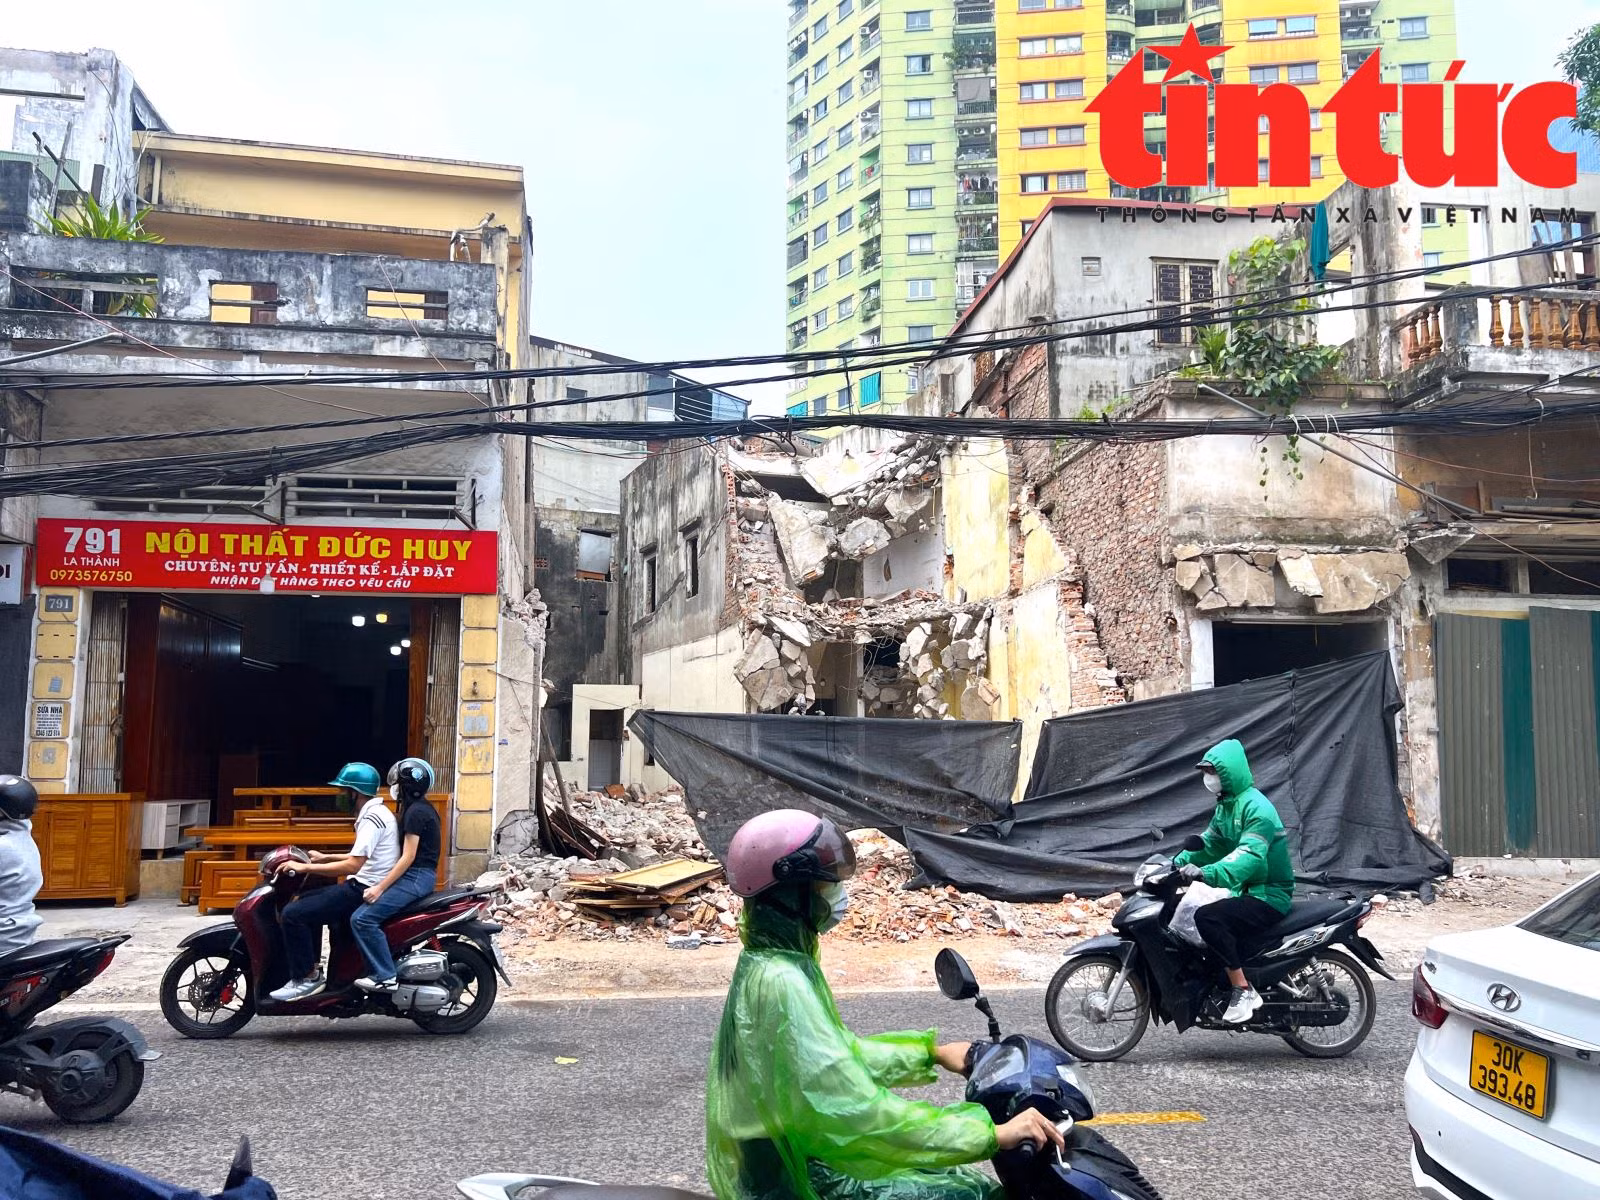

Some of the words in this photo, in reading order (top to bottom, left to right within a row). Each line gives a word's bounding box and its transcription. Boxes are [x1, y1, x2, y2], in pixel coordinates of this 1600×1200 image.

[64, 527, 121, 554] 791
[145, 528, 209, 558] NỘI
[220, 528, 308, 556] THẤT
[318, 532, 391, 559] ĐỨC
[403, 538, 472, 560] HUY
[64, 557, 78, 567] LA
[81, 555, 120, 567] THÀNH
[164, 558, 235, 572] CHUYÊN:
[239, 561, 262, 573] TƯ
[265, 558, 299, 574] VẤN
[310, 560, 356, 575] THIẾT
[359, 560, 380, 576] KẾ
[391, 560, 420, 577] LẮP
[423, 564, 455, 579] ĐẶT
[50, 569, 132, 581] 0973576750
[210, 574, 248, 587] NHẬN
[251, 576, 278, 586] ĐT
[280, 575, 319, 587] HÀNG
[322, 578, 355, 587] THEO
[386, 576, 411, 588] CẦU
[48, 598, 69, 609] 791
[1492, 1042, 1524, 1076] 30K
[1478, 1065, 1536, 1110] 393.48
